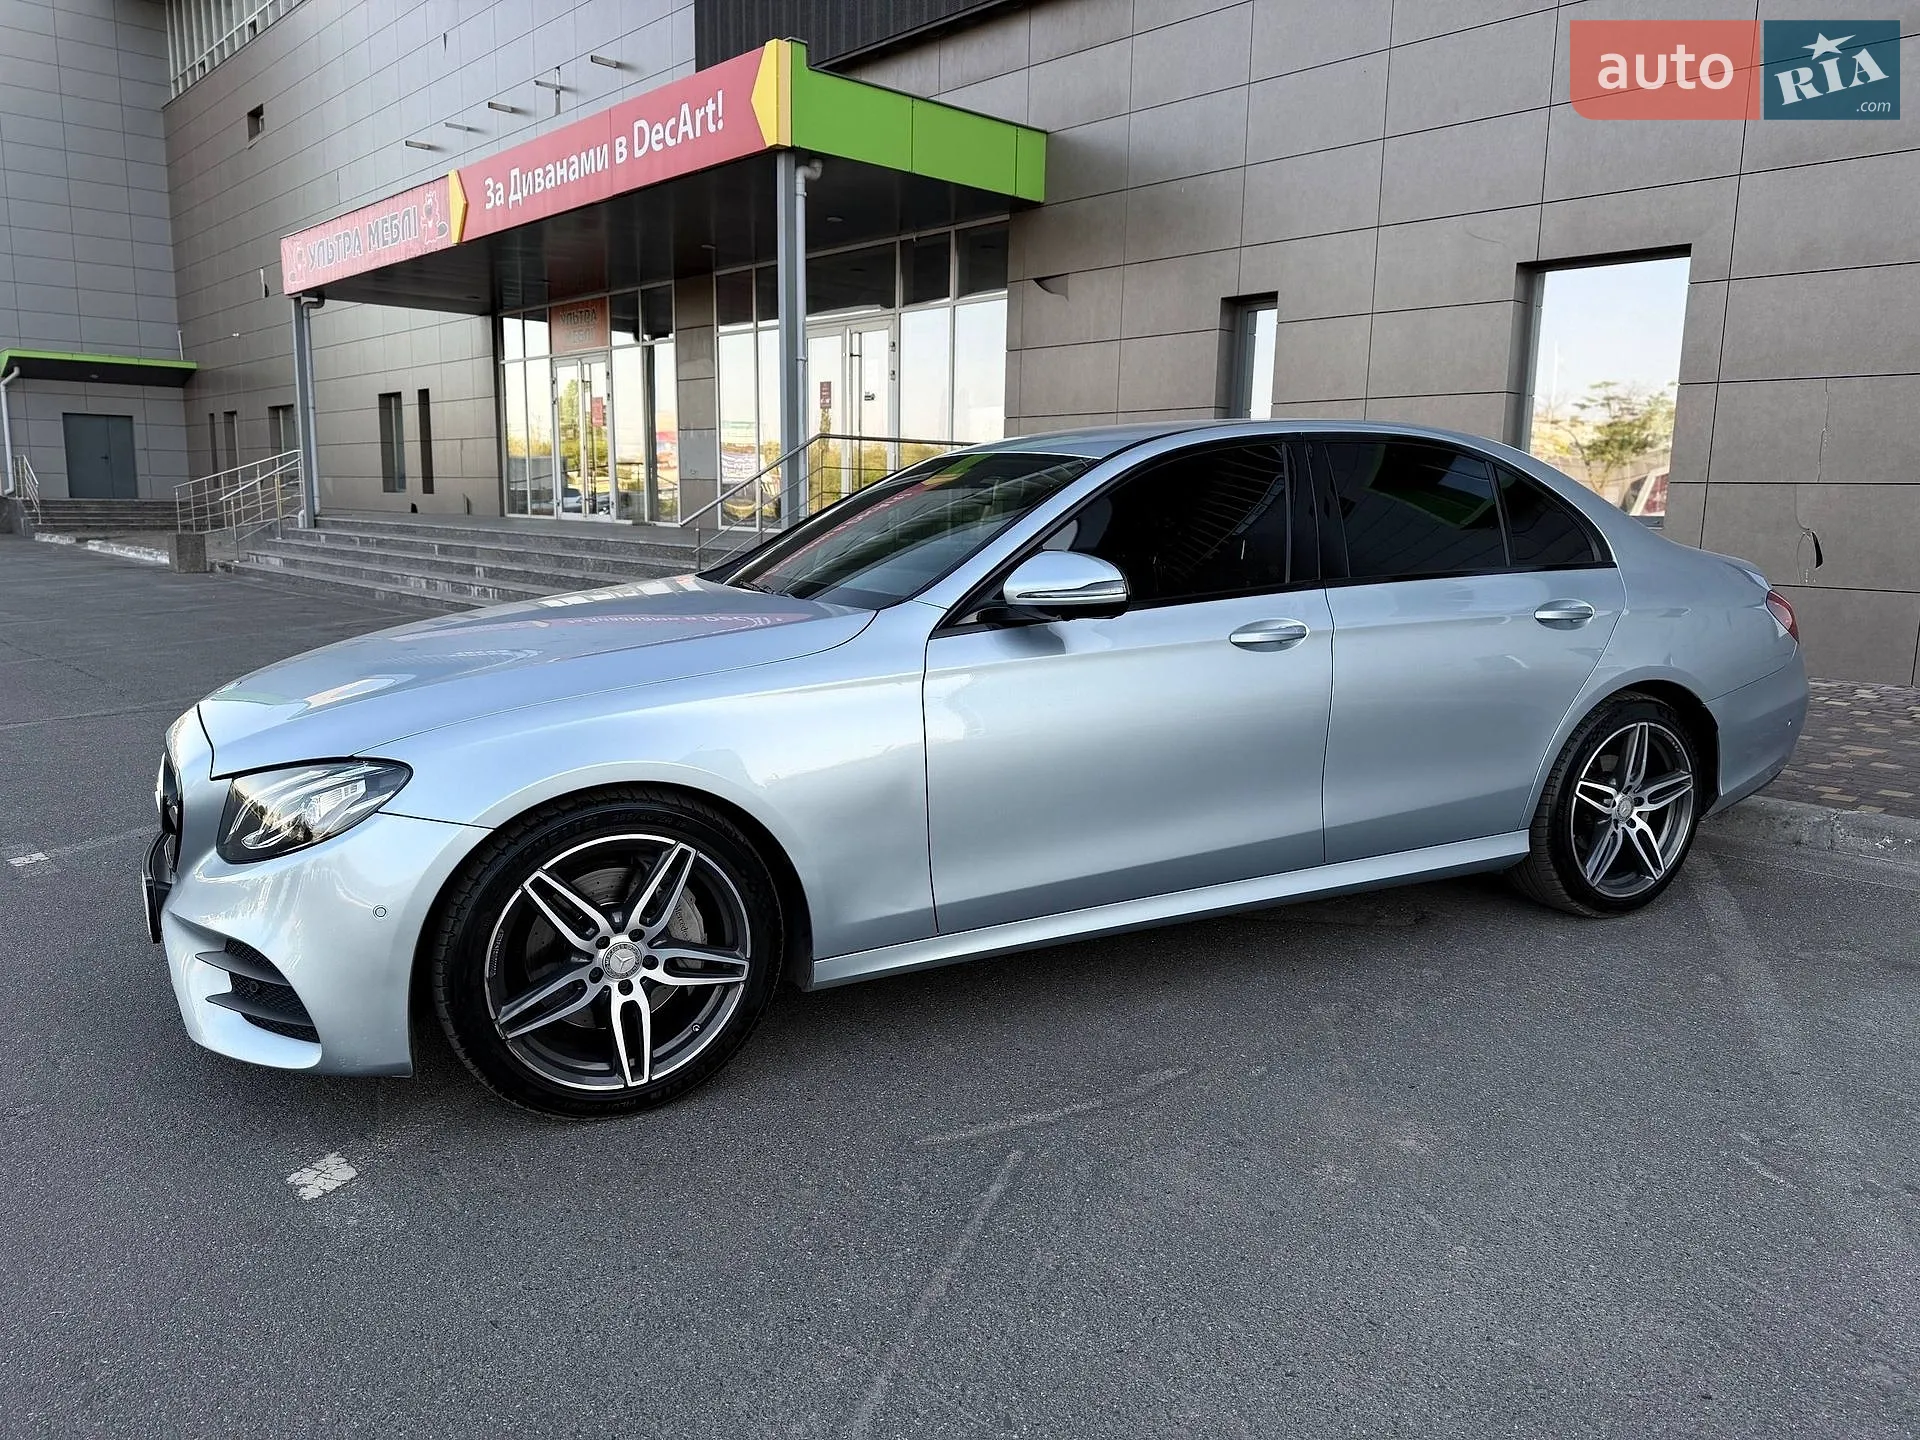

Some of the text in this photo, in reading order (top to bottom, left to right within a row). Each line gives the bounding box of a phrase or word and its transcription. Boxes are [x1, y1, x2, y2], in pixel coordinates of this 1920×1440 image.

[484, 89, 725, 211] За Диванами в DecArt!
[307, 206, 419, 273] УЛЬТРА МЕБЛІ
